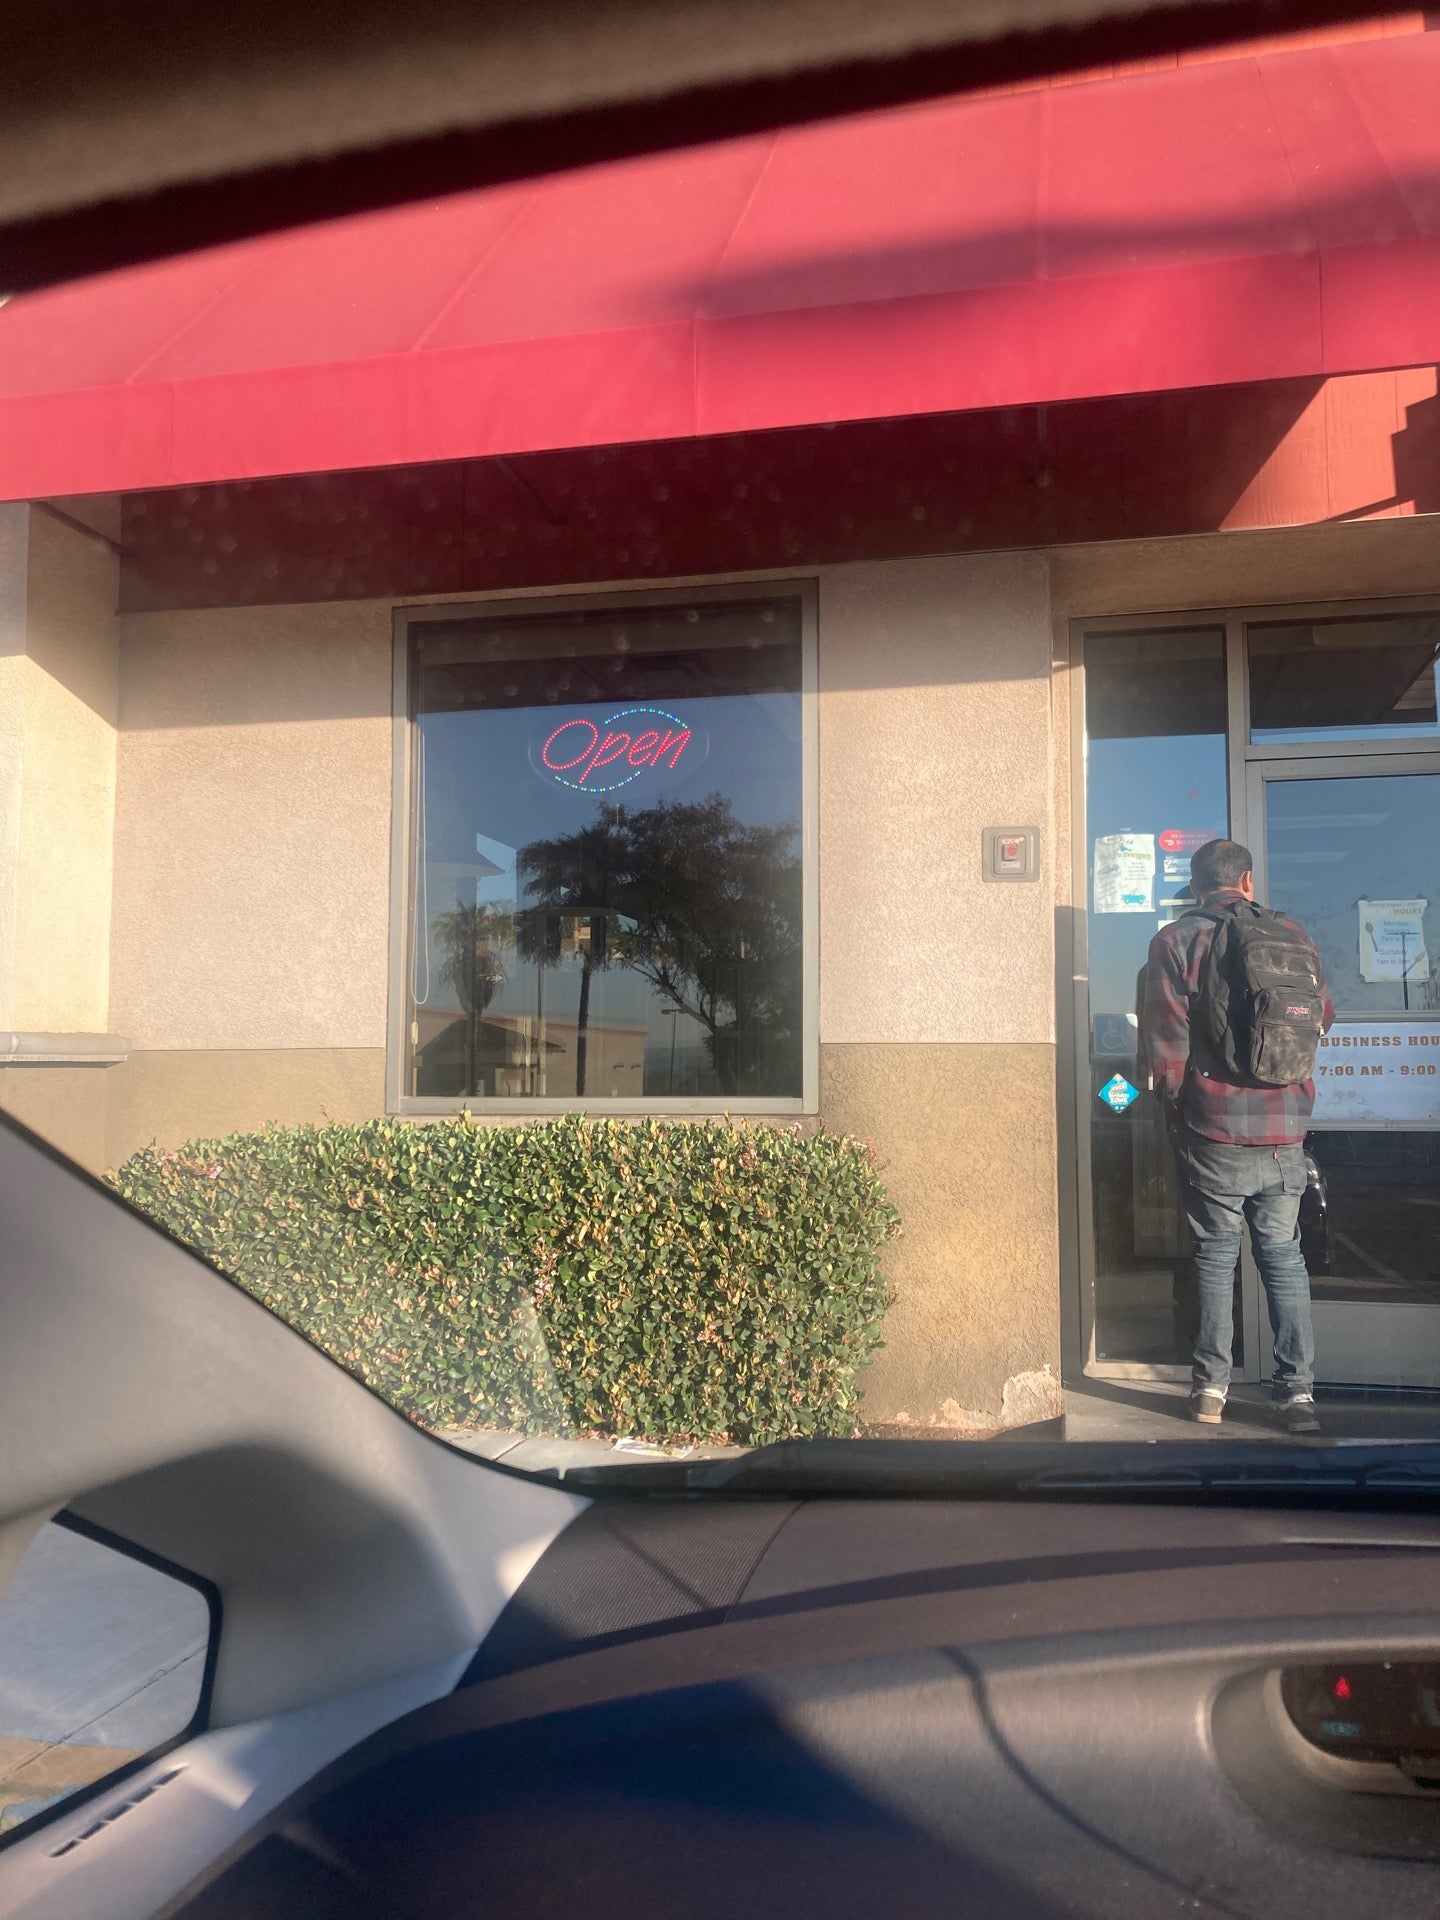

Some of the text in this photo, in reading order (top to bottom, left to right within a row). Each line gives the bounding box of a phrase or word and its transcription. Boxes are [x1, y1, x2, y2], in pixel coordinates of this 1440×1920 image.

[541, 719, 691, 784] Open
[1320, 1037, 1402, 1047] BUSINESS
[1319, 1066, 1355, 1076] 7:00
[1360, 1066, 1384, 1076] AM
[1400, 1065, 1437, 1075] 9:00
